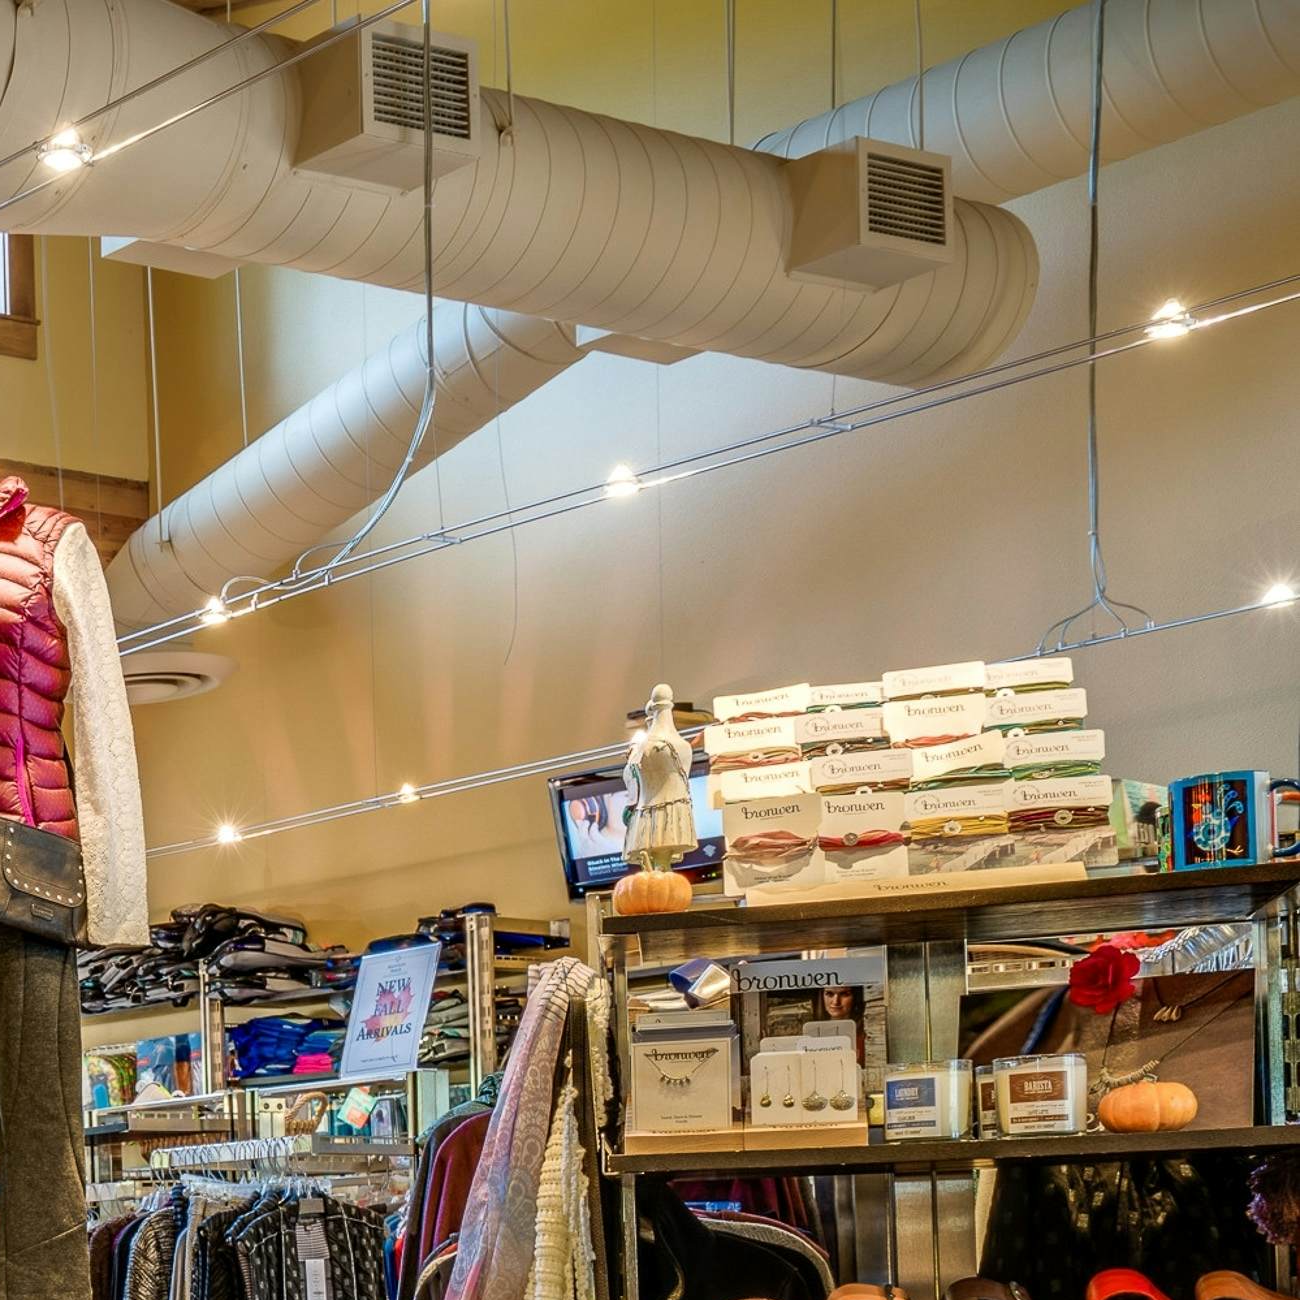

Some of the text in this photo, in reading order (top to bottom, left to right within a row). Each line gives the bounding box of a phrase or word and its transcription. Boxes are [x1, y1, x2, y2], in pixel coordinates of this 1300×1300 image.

[904, 703, 966, 717] bronwen
[998, 703, 1054, 716] bronwen
[724, 725, 783, 739] bronwen
[811, 721, 864, 733] bronwen
[921, 743, 984, 763] bronwen
[1013, 742, 1070, 756] bronwen
[828, 762, 882, 775] bronwen
[742, 769, 800, 784] bronwen
[1021, 790, 1078, 803] bronwen
[741, 802, 801, 820] bronwen
[825, 800, 886, 814] bronwen
[921, 799, 976, 811] bronwen
[873, 880, 949, 892] bronwen
[376, 977, 411, 997] NEW
[731, 968, 843, 992] bronwen
[373, 999, 405, 1017] FALL
[356, 1022, 412, 1041] ARRIVALS
